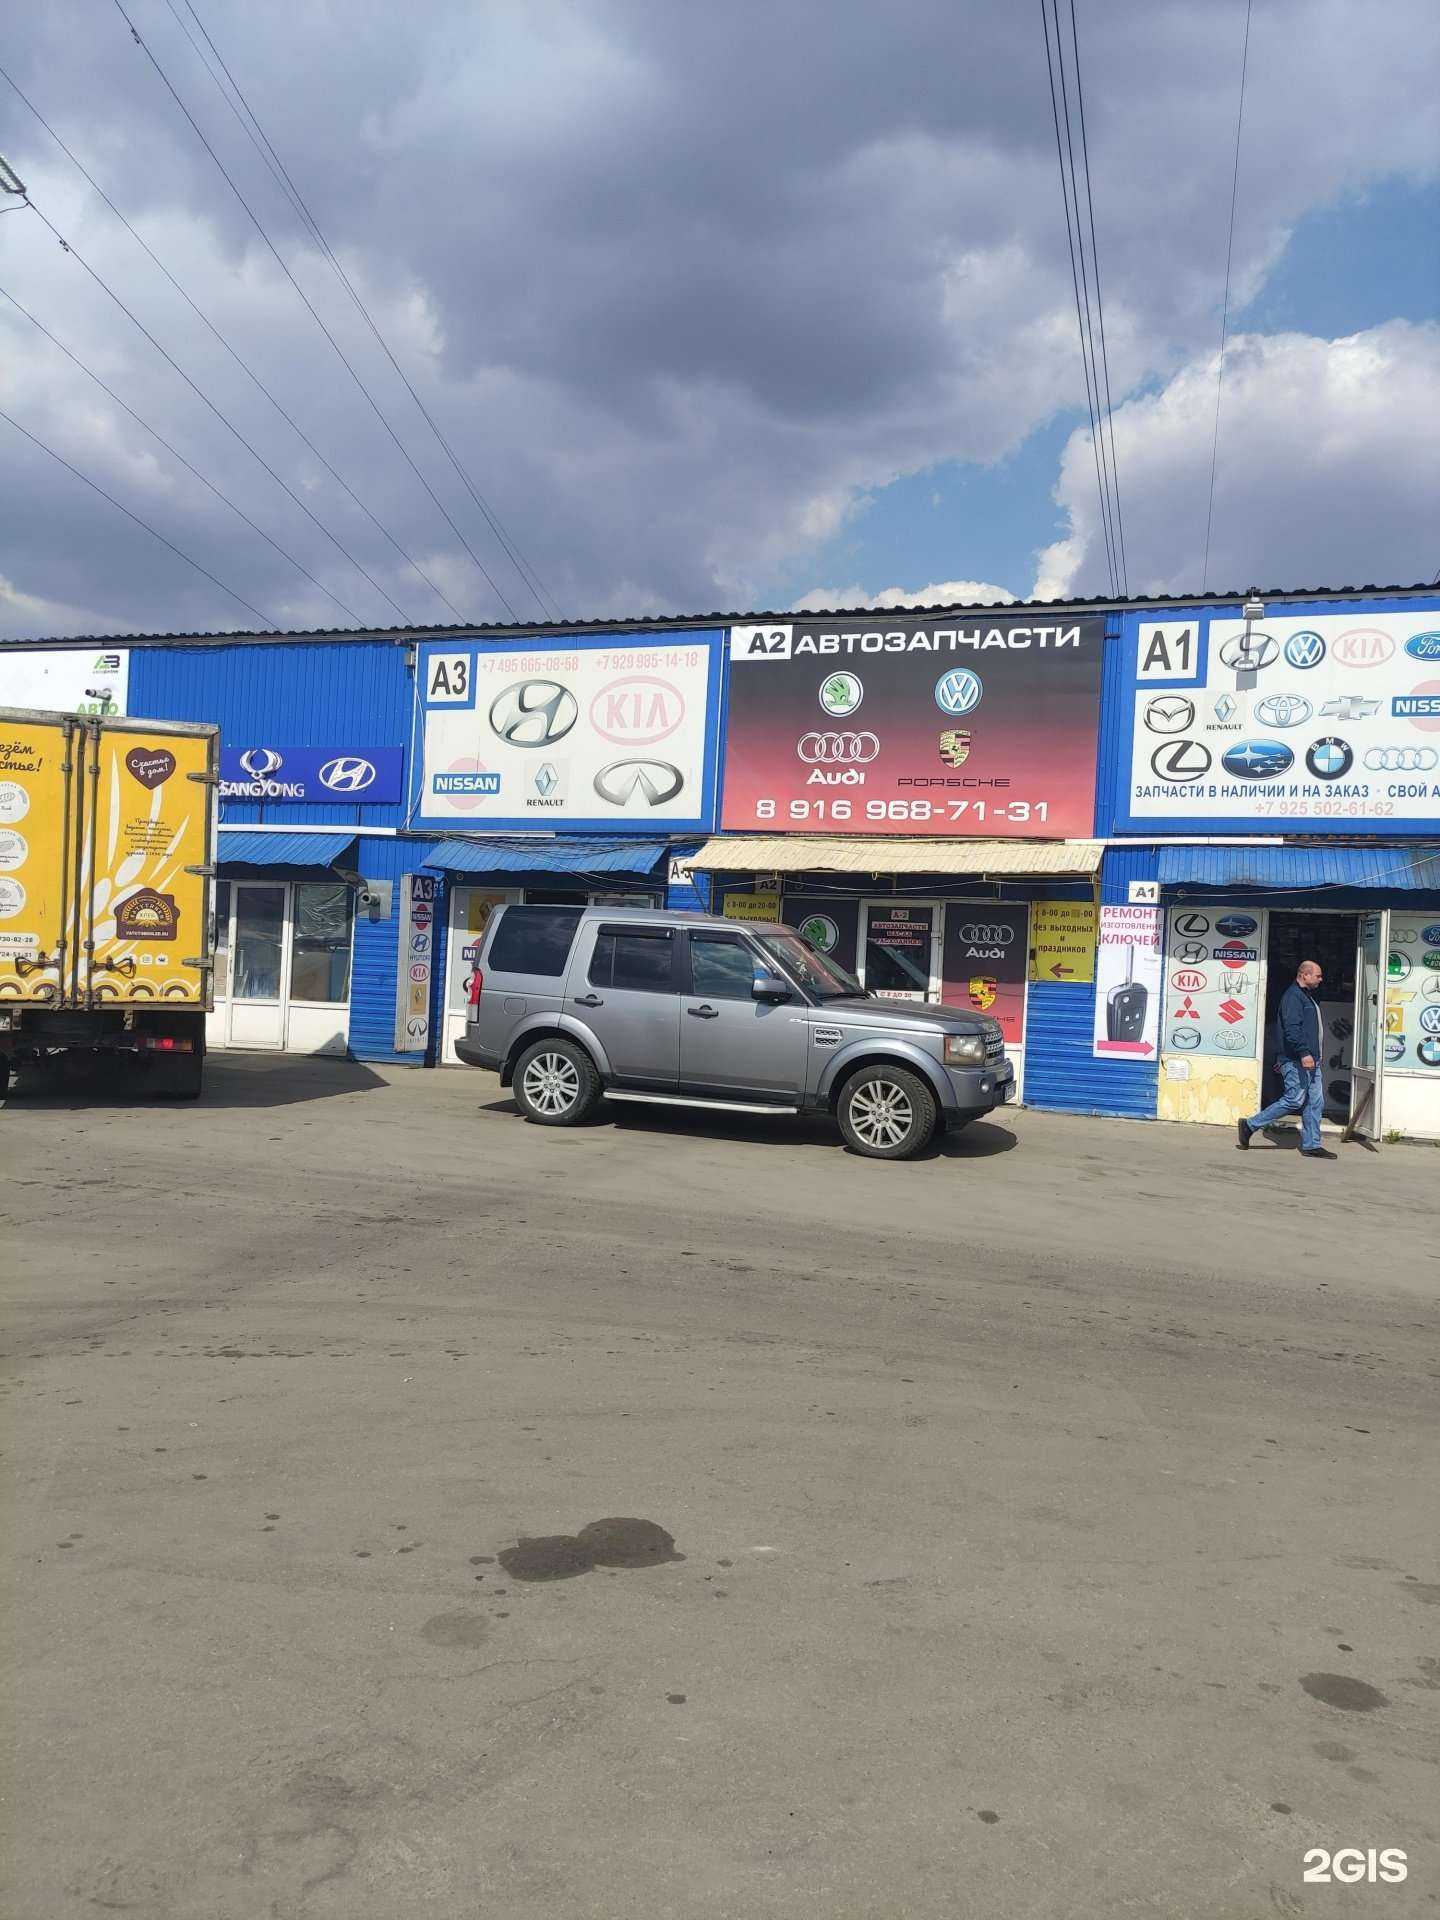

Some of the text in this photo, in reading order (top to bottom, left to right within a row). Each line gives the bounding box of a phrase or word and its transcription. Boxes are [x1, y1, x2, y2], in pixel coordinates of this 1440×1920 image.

[794, 627, 1081, 656] АВТОЗАПЧАСТИ
[1417, 636, 1440, 655] For
[1342, 640, 1385, 658] KIA
[606, 693, 670, 729] KIA
[1395, 699, 1440, 713] NISS
[1206, 723, 1243, 731] RENAULT
[0, 741, 35, 760] езём
[1312, 737, 1350, 752] BMW
[0, 757, 43, 772] стье!
[435, 776, 498, 791] NISSAN
[806, 768, 865, 785] Audi
[898, 778, 1010, 788] PORSCHE
[1135, 784, 1204, 798] ЗАПЧАСТИ
[1208, 785, 1217, 798] В
[1220, 784, 1286, 798] НАЛИЧИИ
[1289, 785, 1299, 798] И
[1302, 785, 1321, 798] НА
[1324, 785, 1370, 798] ЗАКАЗ
[1387, 781, 1427, 798] СВОЙ
[526, 798, 565, 807] RENAULT
[1255, 801, 1394, 816] +7 925 502-61-62
[755, 799, 1049, 823] 8 916 968-71-31
[1103, 907, 1161, 919] РЕМОНТ
[1050, 925, 1093, 933] выходных
[1102, 932, 1160, 946] КЛЮЧЕЙ
[965, 947, 1005, 959] Audi
[1038, 945, 1087, 954] праздников
[1215, 950, 1257, 960] NISSAN
[412, 967, 427, 978] KIA
[1177, 974, 1200, 987] KIA
